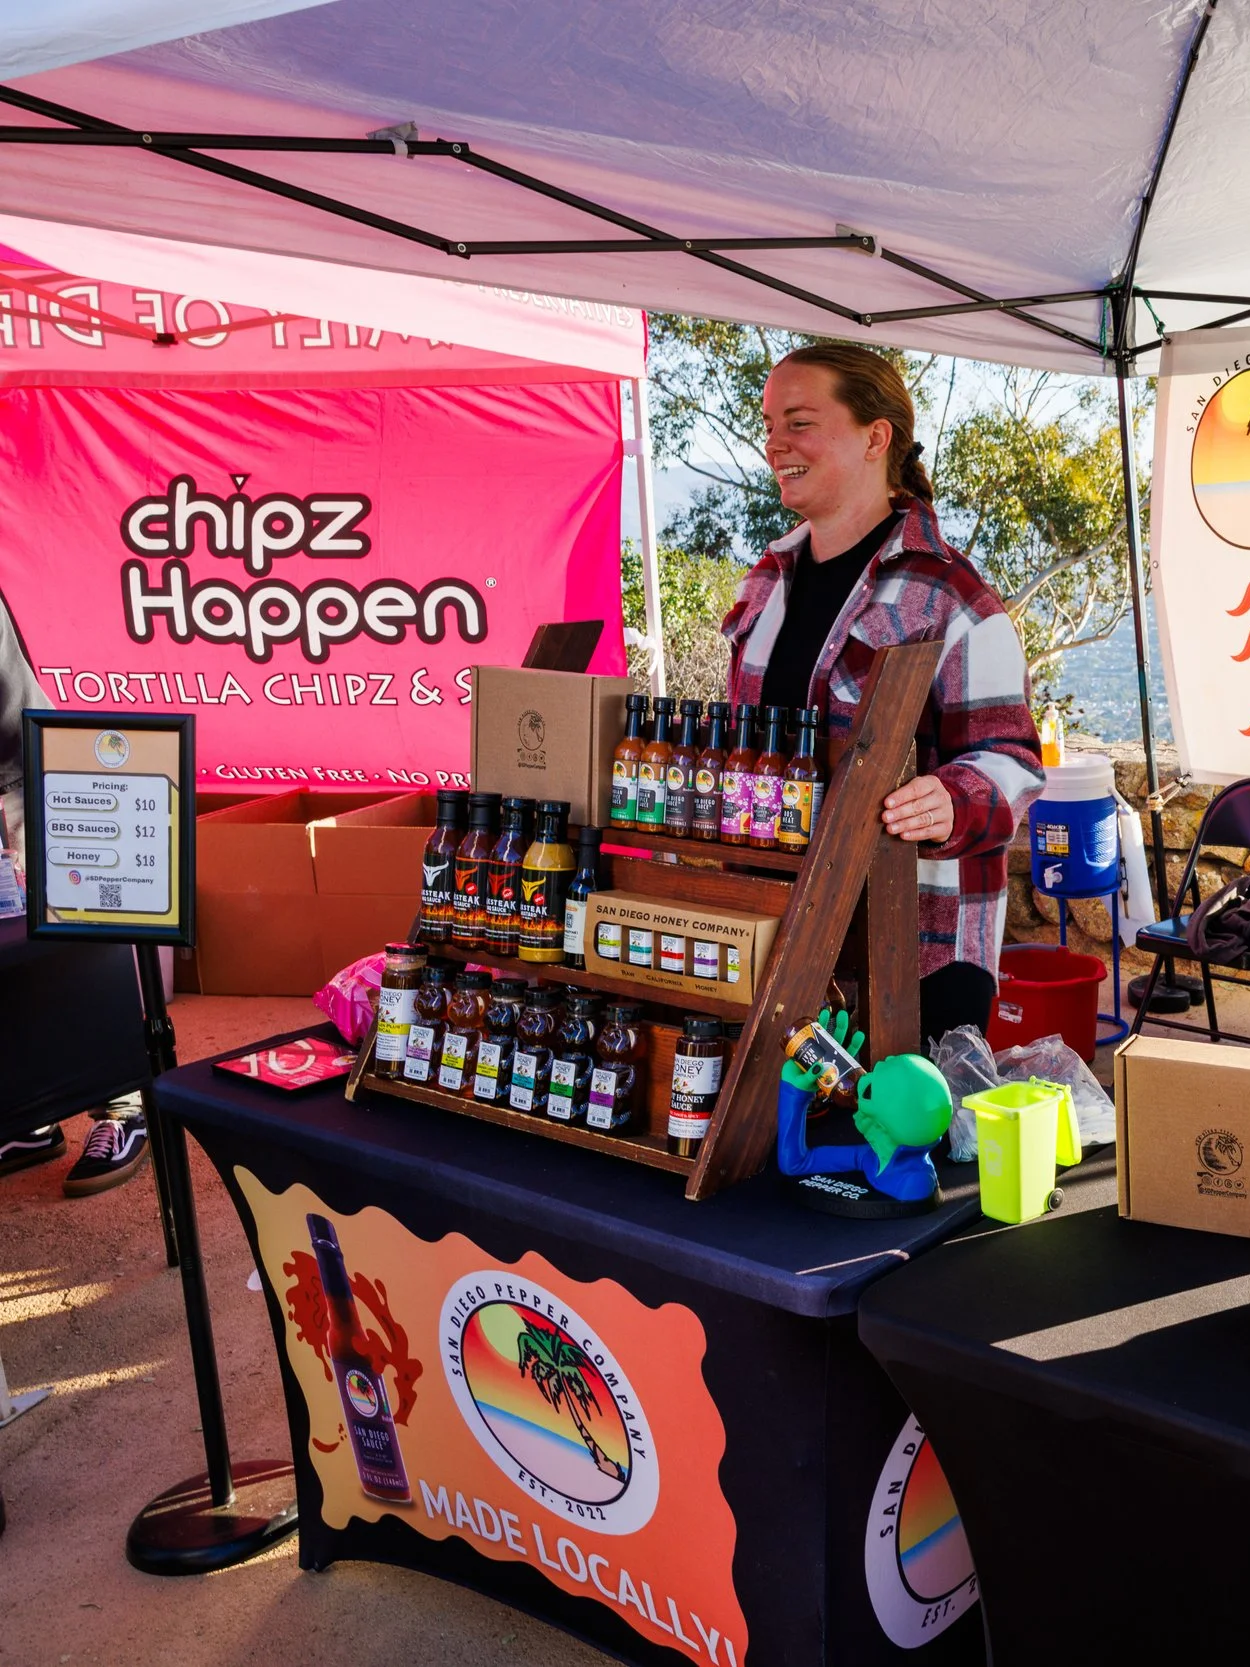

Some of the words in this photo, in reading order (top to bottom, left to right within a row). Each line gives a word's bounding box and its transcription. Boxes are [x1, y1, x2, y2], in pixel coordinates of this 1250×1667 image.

[1186, 395, 1207, 433] SAN
[121, 474, 371, 576] chipz
[124, 560, 487, 663] Happen
[38, 665, 255, 707] TORTILLA
[263, 672, 398, 707] CHIPZ
[409, 668, 444, 707] &
[92, 782, 129, 792] Pricing:
[214, 763, 310, 781] GLUTEN
[313, 766, 365, 783] FREE
[386, 768, 430, 786] NO
[53, 795, 71, 804] Hot
[74, 796, 112, 806] Sauces
[135, 798, 156, 811] $10
[51, 823, 74, 833] BBQ
[77, 824, 116, 834] Sauces
[135, 825, 156, 839] $12
[67, 851, 101, 863] Honey
[135, 854, 155, 867] $18
[596, 905, 616, 916] SAN
[619, 909, 651, 921] DIEGO
[653, 914, 689, 929] HONEY
[692, 921, 746, 938] COMPANY
[695, 984, 718, 993] HONEY
[675, 1064, 703, 1075] ONEY
[677, 1094, 705, 1103] HONEY
[798, 1179, 841, 1194] PEPPER
[841, 1189, 860, 1200] CO.
[810, 1175, 833, 1187] SAN
[834, 1179, 869, 1194] DIEGO
[450, 1285, 486, 1329] DIEGO
[494, 1283, 569, 1330] PEPPER
[448, 1336, 463, 1378] SAN
[583, 1339, 646, 1460] COMPANY
[361, 1437, 383, 1450] SAUCE
[368, 1429, 390, 1442] DIEGO
[518, 1469, 554, 1504] EST.
[565, 1500, 607, 1521] 2022
[880, 1480, 903, 1538] SAN
[418, 1479, 528, 1557] MADE
[532, 1522, 738, 1667] LOCALLY!
[921, 1599, 956, 1628] EST.
